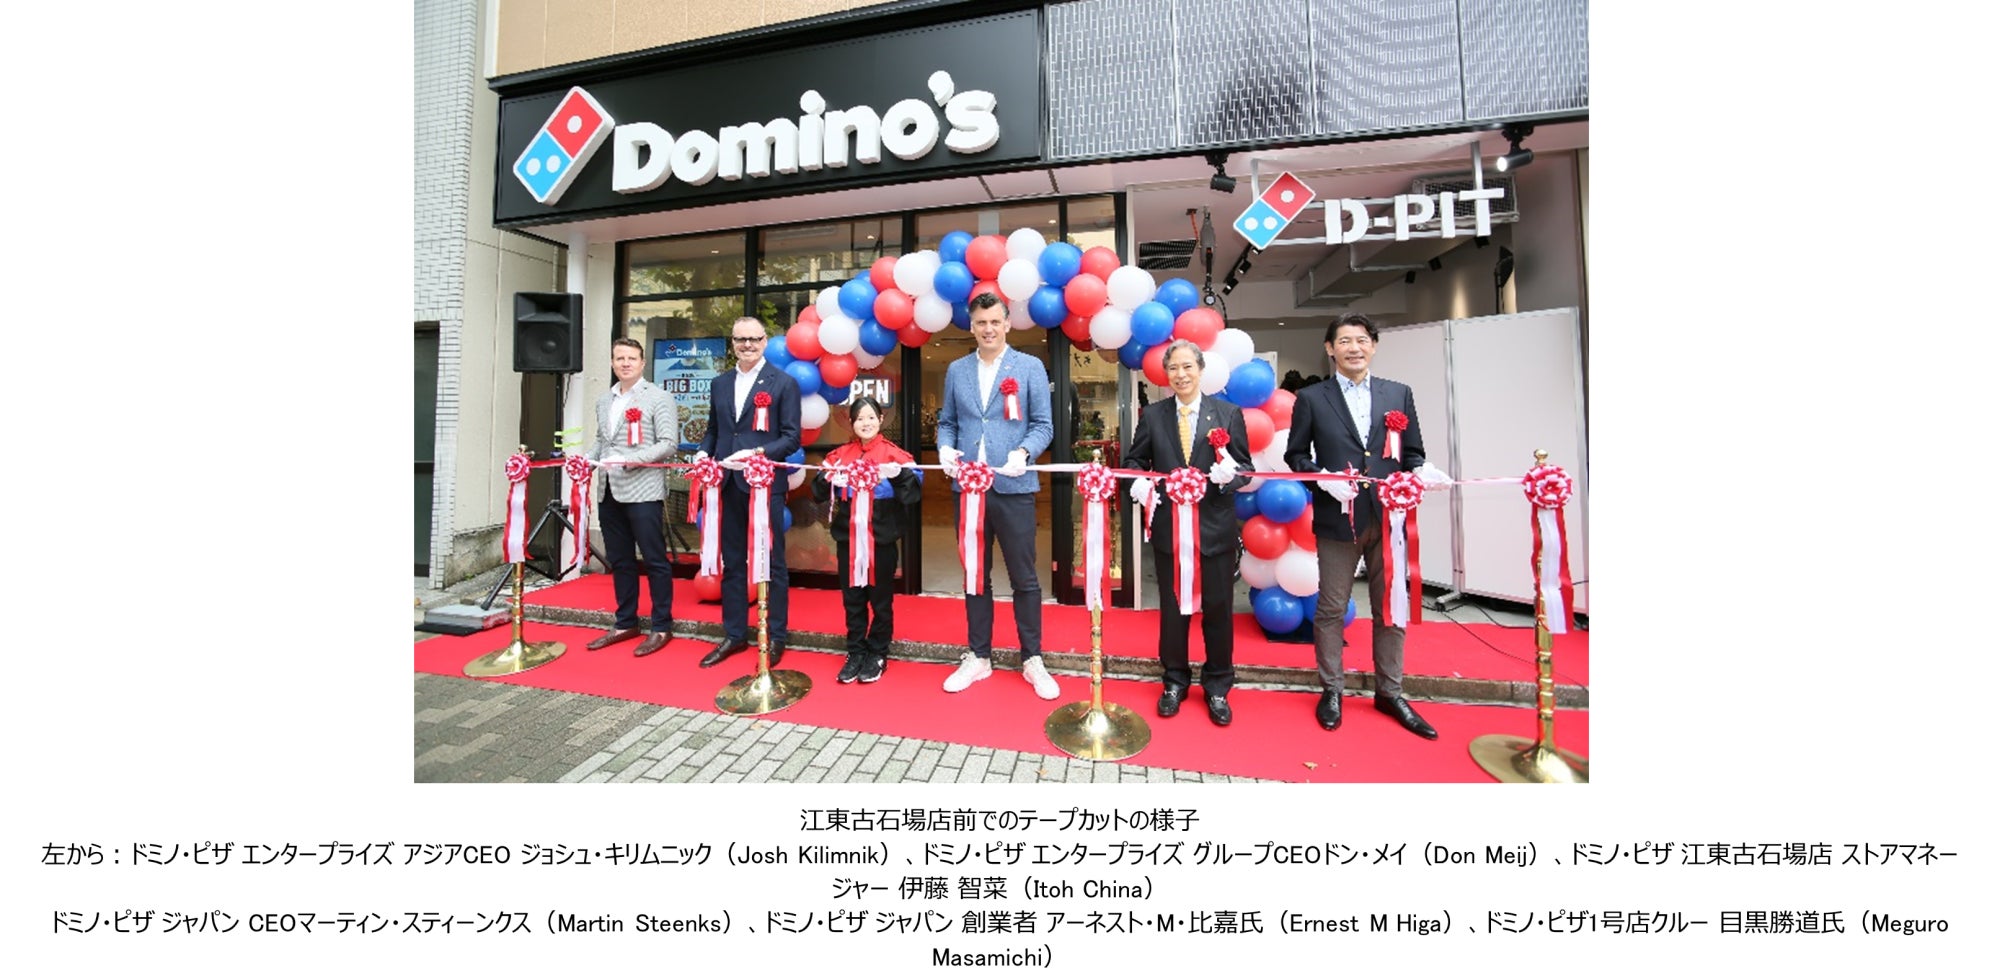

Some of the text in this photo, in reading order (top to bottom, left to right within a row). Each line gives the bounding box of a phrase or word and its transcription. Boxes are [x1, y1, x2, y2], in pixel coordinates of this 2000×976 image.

[612, 70, 1000, 194] Domino's
[1324, 187, 1505, 245] D-PIT
[666, 379, 712, 392] BIG BOX
[839, 379, 889, 406] PEN
